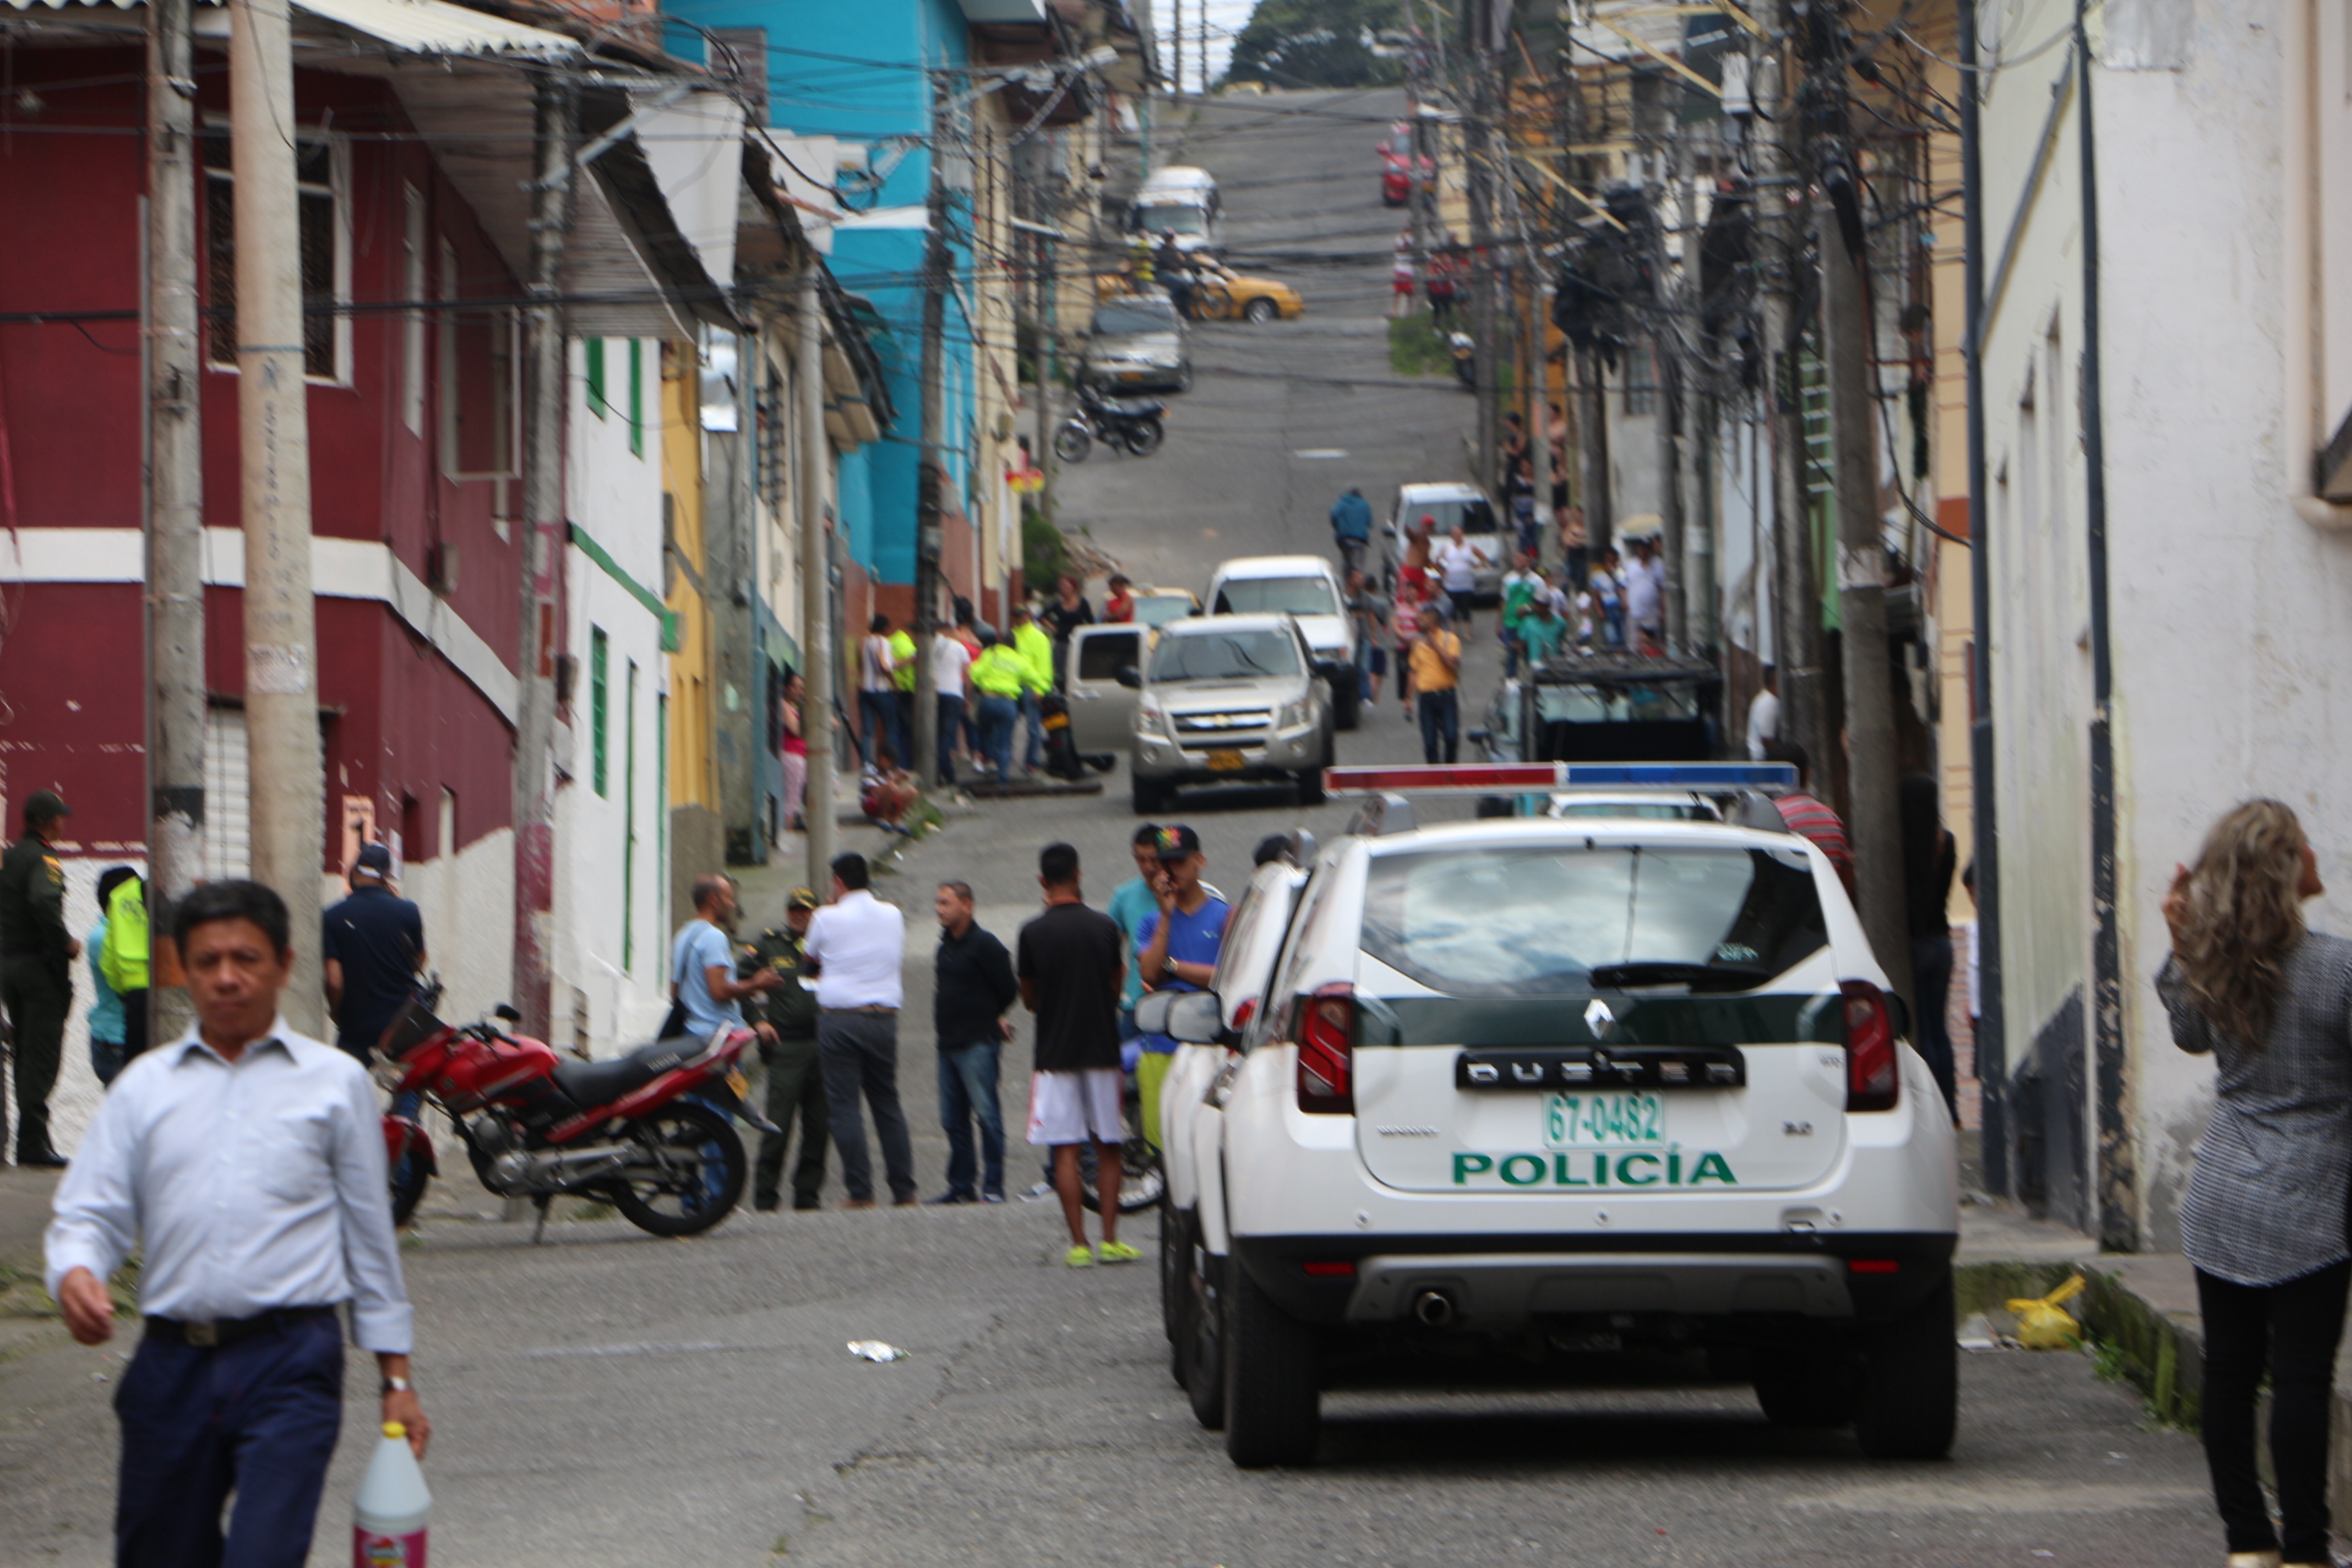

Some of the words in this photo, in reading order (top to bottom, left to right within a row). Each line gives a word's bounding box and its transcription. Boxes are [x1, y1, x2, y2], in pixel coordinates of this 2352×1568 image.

[1467, 1062, 1737, 1083] DUSTER
[1548, 1094, 1661, 1142] 67-0482
[1451, 1141, 1739, 1186] POLICÍA
